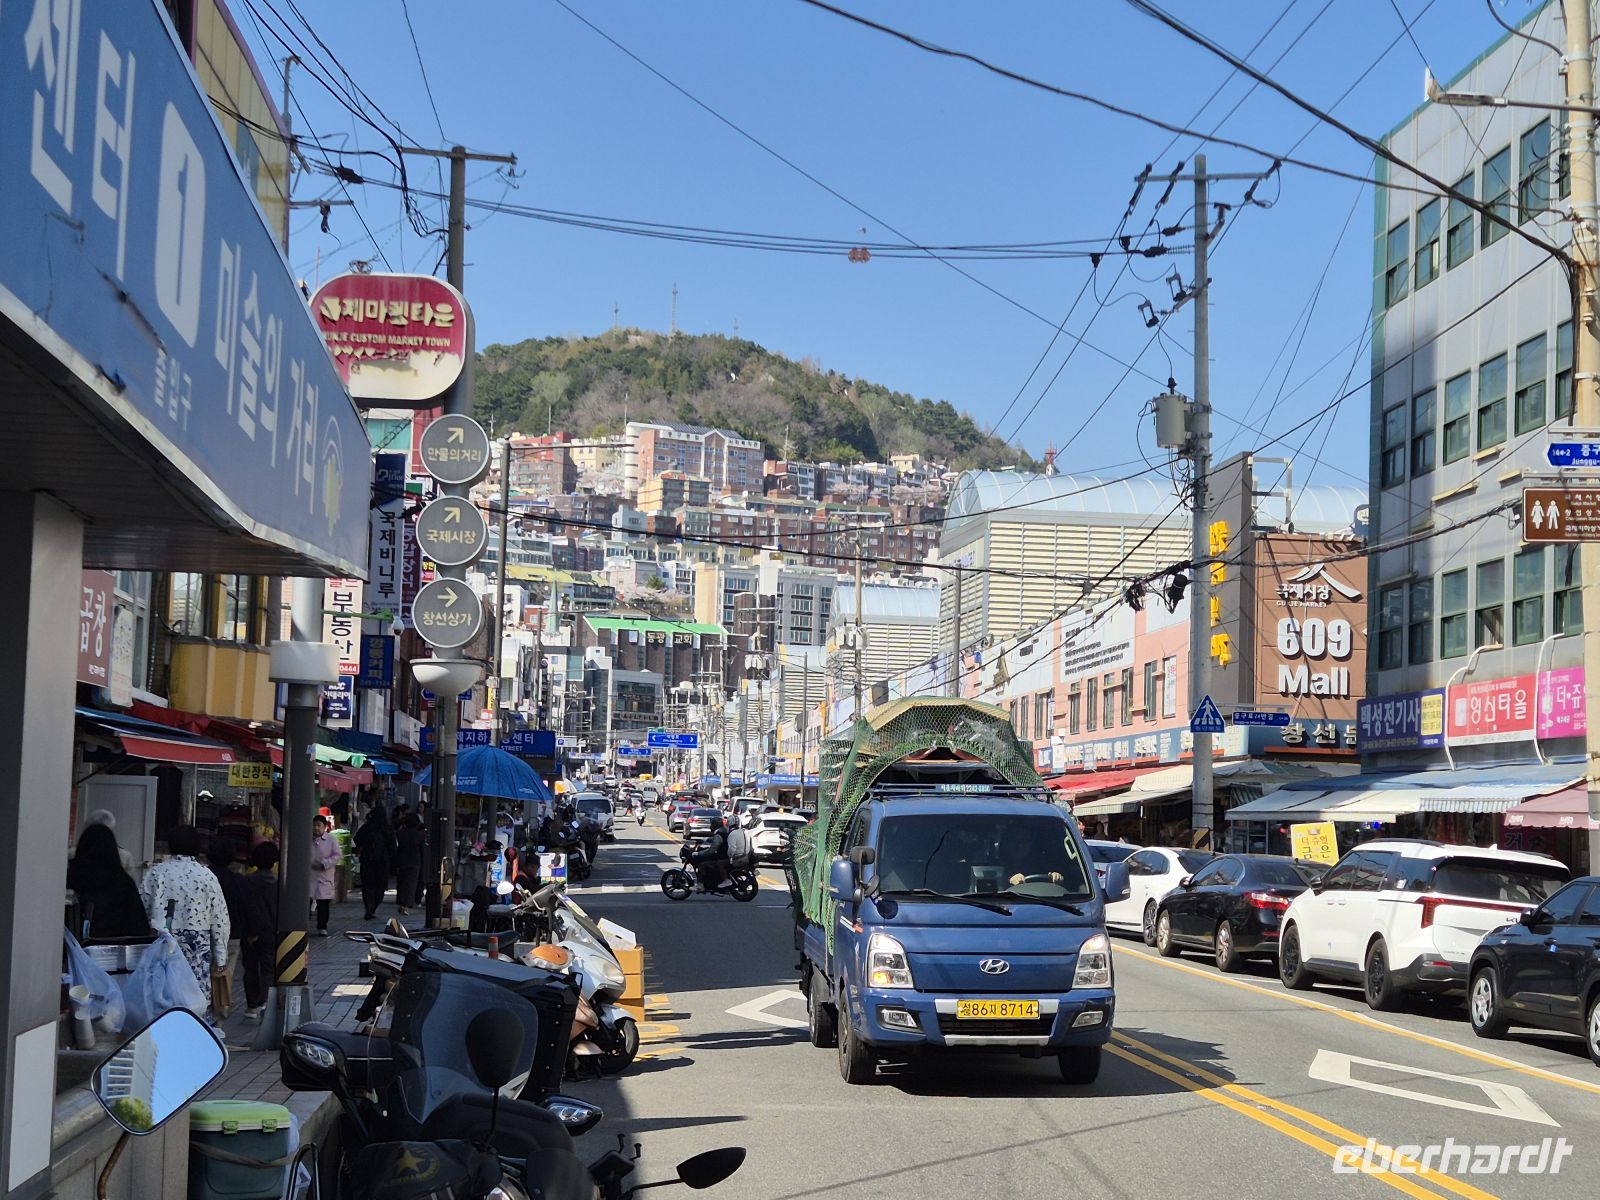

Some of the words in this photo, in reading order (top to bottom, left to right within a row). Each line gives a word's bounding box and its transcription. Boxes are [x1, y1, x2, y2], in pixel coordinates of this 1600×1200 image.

[350, 333, 386, 344] CUSTOM
[388, 336, 423, 346] MARKET
[426, 337, 451, 347] TOWN
[214, 238, 283, 467] 미술의
[287, 358, 318, 514] 거리
[425, 529, 476, 544] 국제시장
[378, 511, 397, 598] 국제비니루
[1275, 583, 1331, 600] 국제시장
[1300, 601, 1327, 609] MARKET
[331, 592, 353, 660] 부동산
[422, 611, 473, 626] 창선상가
[674, 634, 692, 645] 교회
[1277, 617, 1351, 658] 609
[1277, 664, 1348, 695] Mall
[1471, 689, 1527, 724] 영신타올
[1361, 698, 1420, 737] 백성전기사
[232, 765, 271, 779] 대한장식
[1000, 1004, 1034, 1016] 8714
